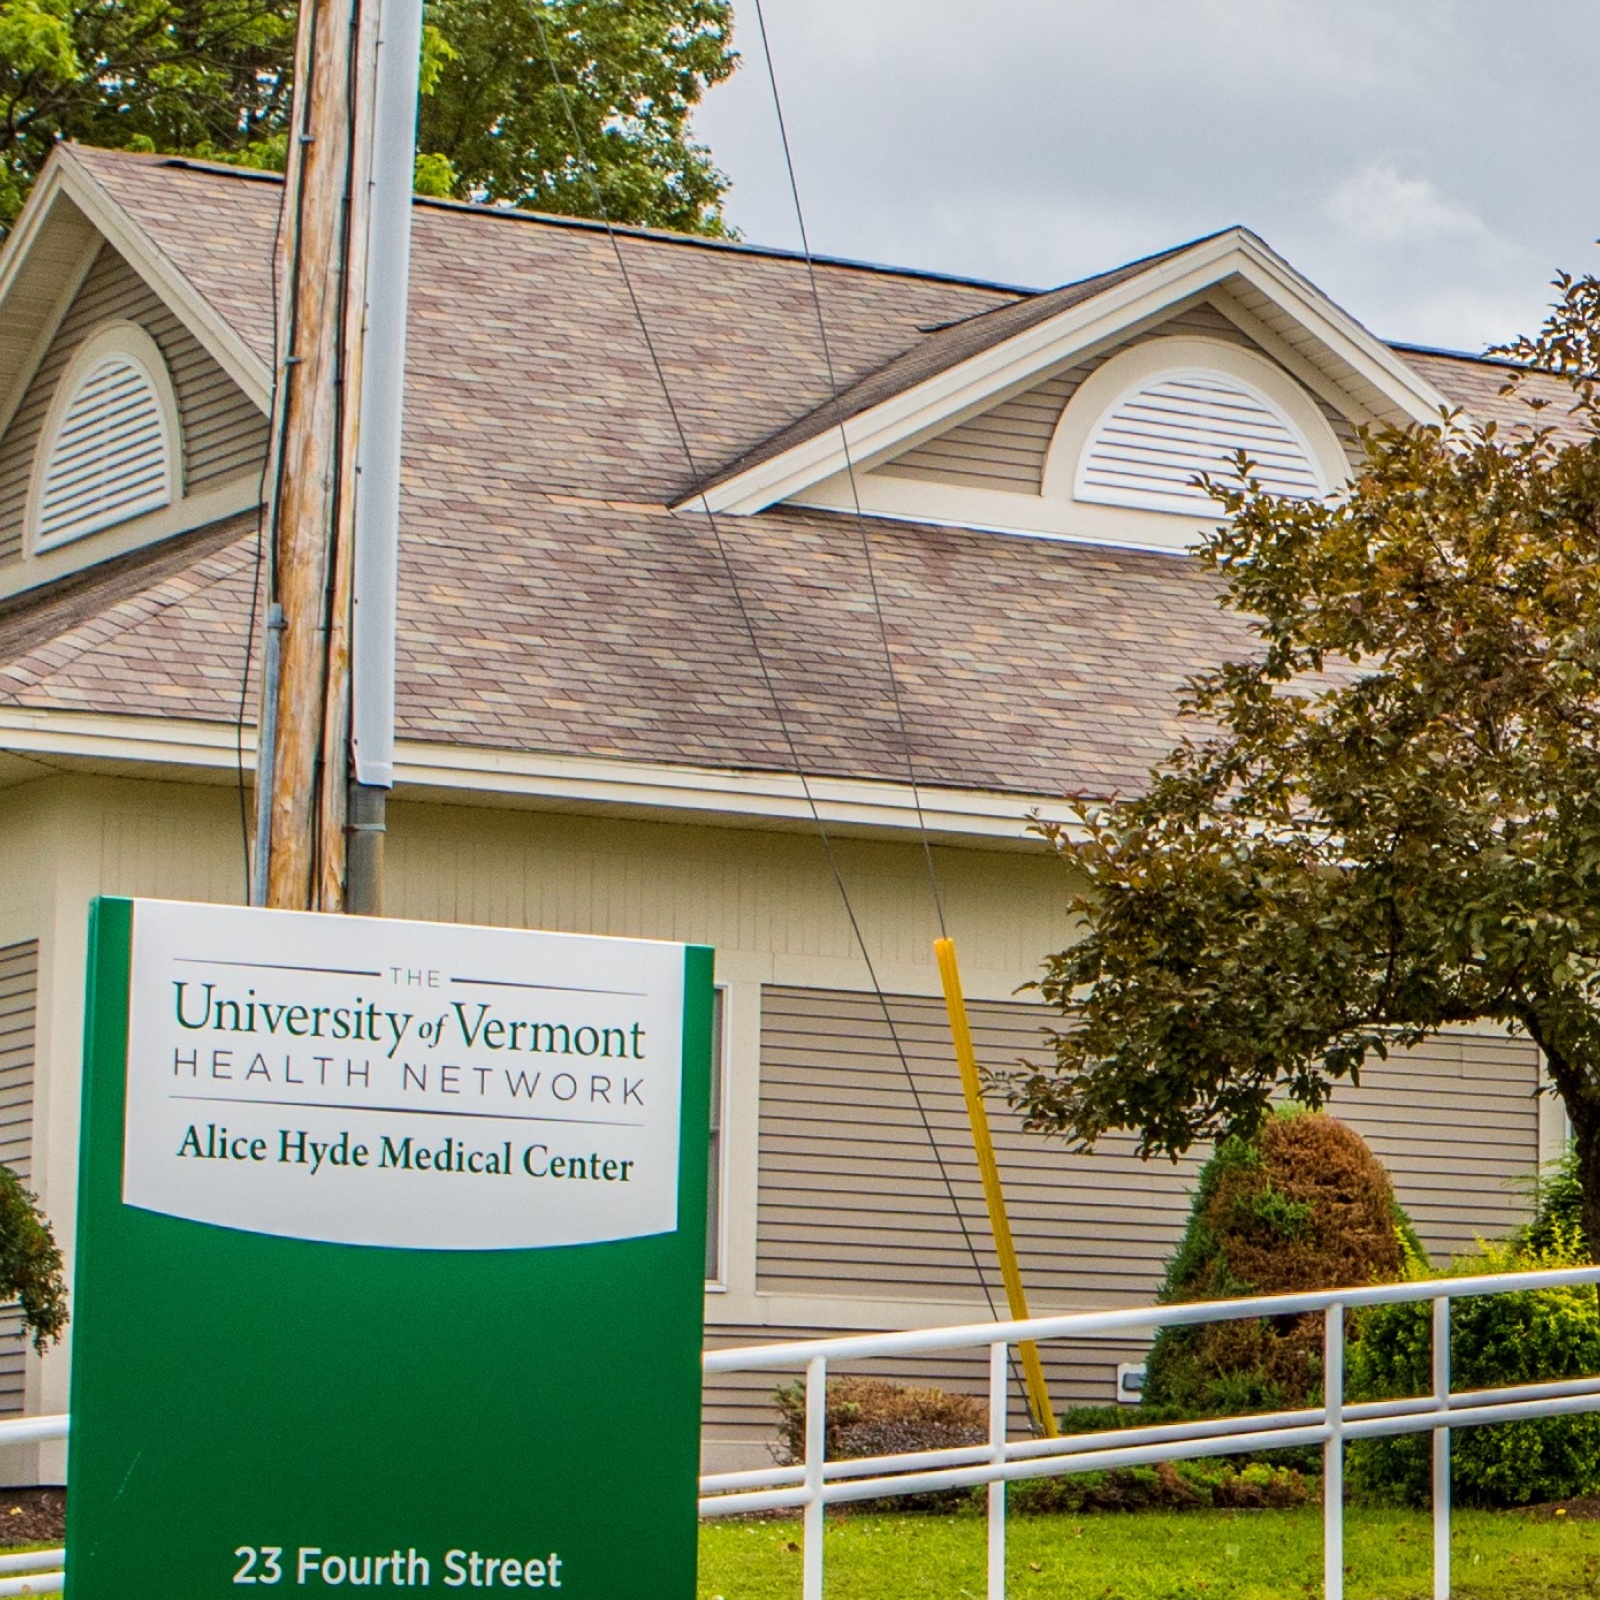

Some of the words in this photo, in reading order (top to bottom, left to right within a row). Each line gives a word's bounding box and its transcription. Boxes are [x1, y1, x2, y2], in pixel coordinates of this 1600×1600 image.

[389, 967, 440, 988] THE
[172, 981, 414, 1059] University
[418, 1014, 449, 1049] of
[450, 1002, 646, 1059] Vermont
[174, 1048, 369, 1088] HEALTH
[403, 1063, 644, 1106] NETWORK
[176, 1124, 267, 1161] Alice
[278, 1130, 369, 1176] Hyde
[378, 1136, 512, 1175] Medical
[523, 1144, 634, 1182] Center
[233, 1546, 282, 1584] 23
[297, 1547, 430, 1586] Fourth
[443, 1549, 562, 1588] Street
